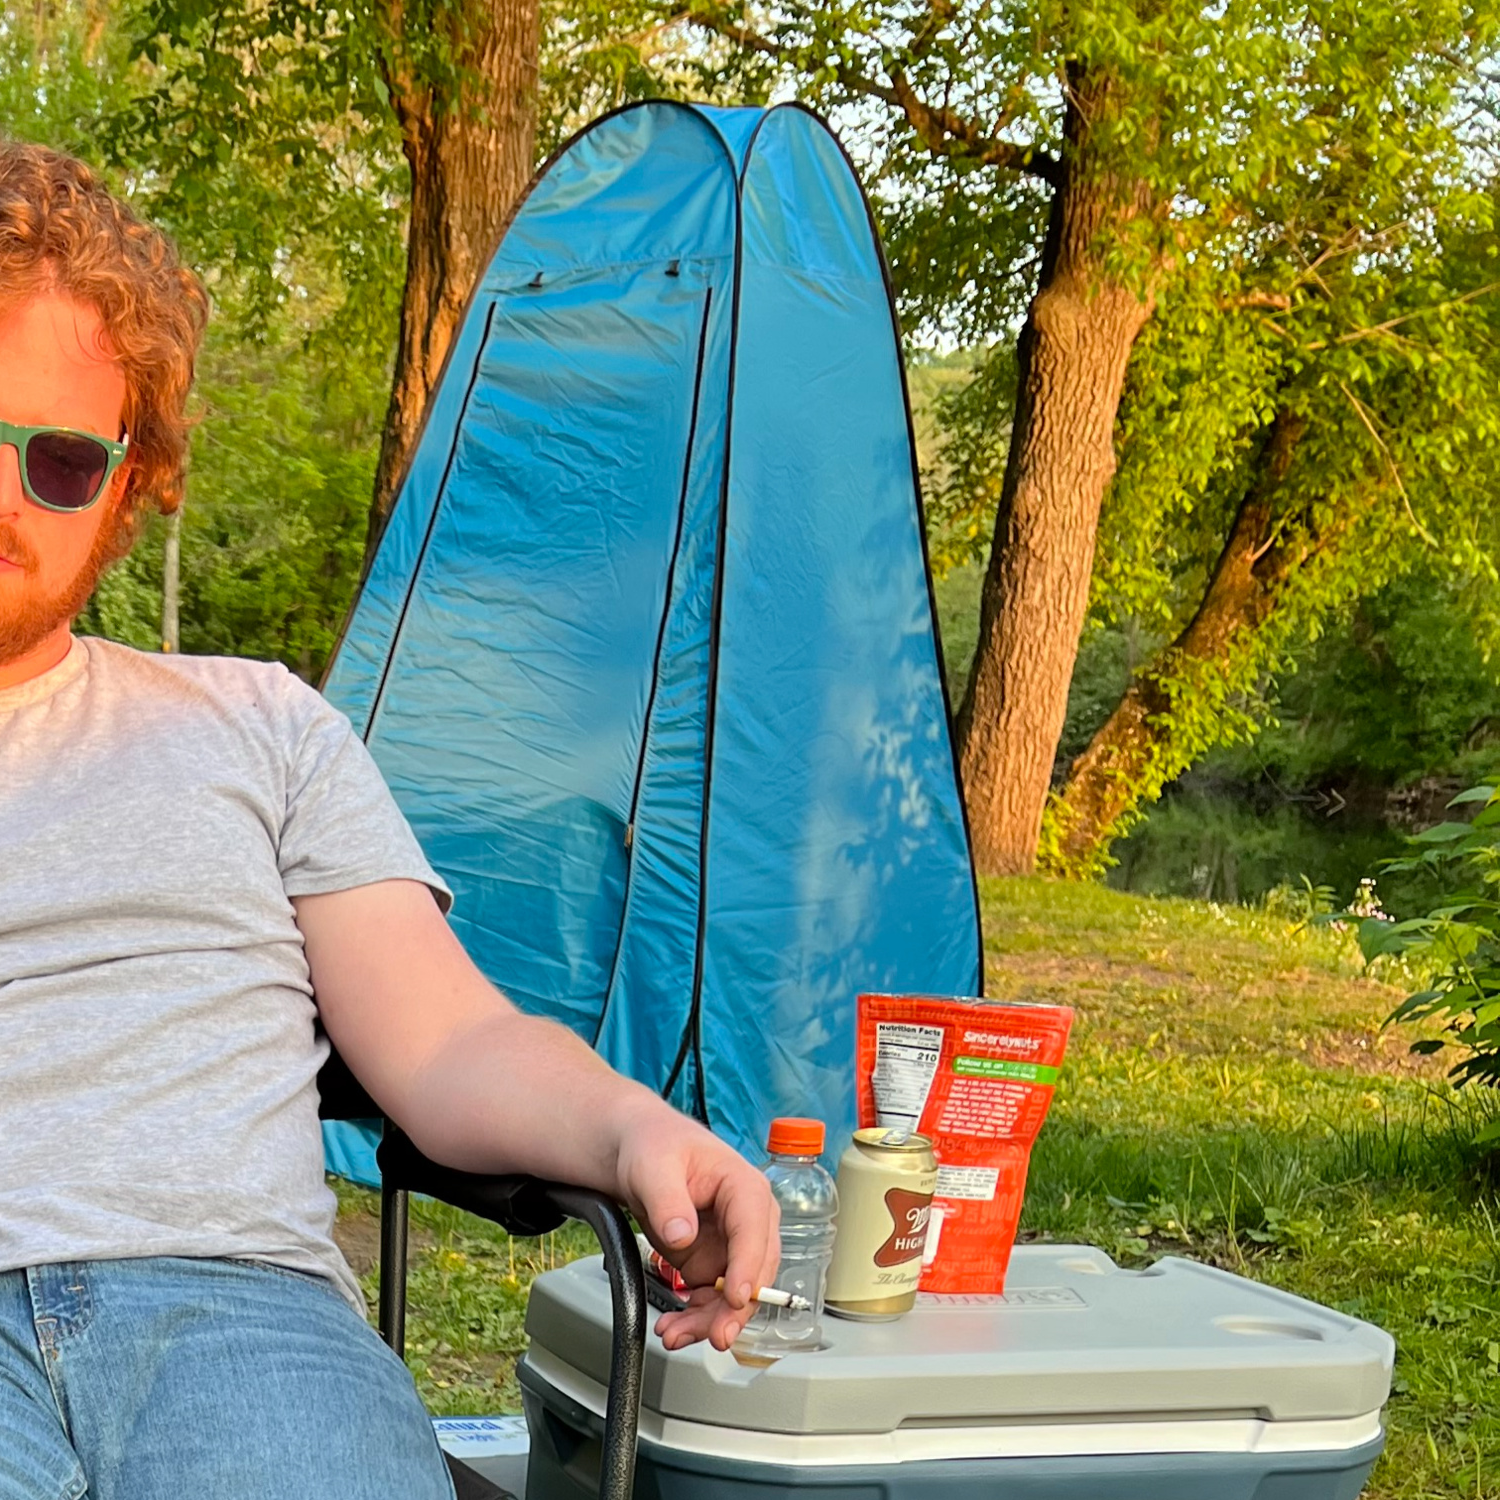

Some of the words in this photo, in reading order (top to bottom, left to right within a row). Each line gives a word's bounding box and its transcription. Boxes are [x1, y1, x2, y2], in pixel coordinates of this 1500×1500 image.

[879, 1025, 917, 1034] Nutrition
[919, 1028, 941, 1037] Facts
[917, 1052, 937, 1062] 210
[437, 1420, 505, 1431] atural
